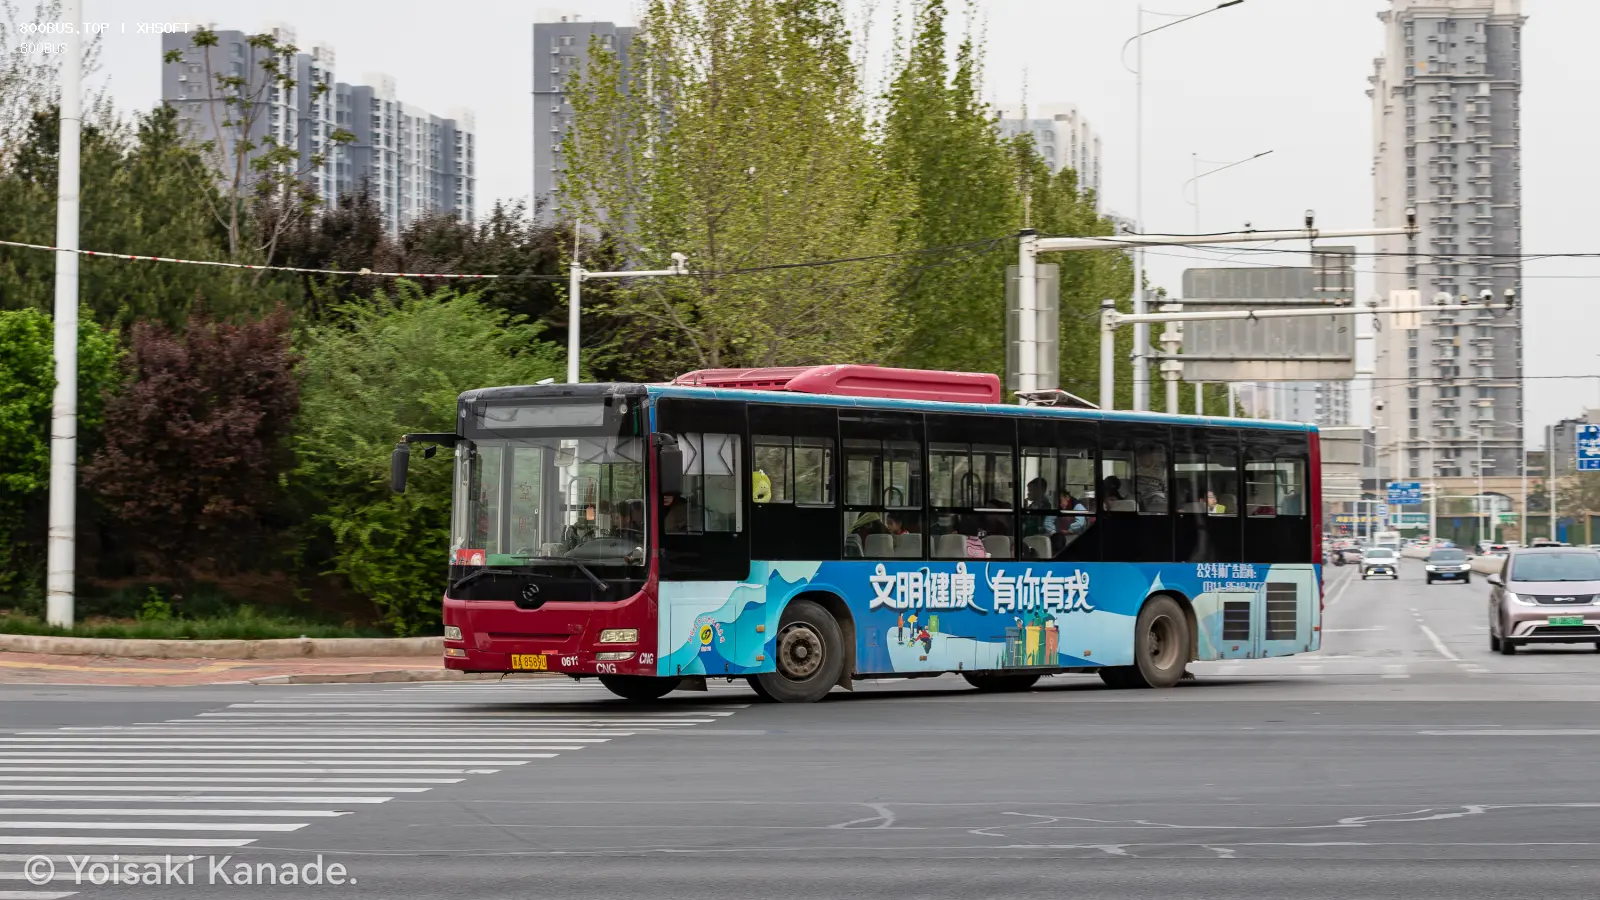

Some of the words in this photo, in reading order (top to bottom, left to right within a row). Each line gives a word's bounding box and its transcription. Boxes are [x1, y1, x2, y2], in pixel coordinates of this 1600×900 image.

[869, 562, 988, 613] 文明健康
[985, 562, 1095, 614] 有你有我
[639, 652, 654, 665] CNG
[596, 662, 617, 674] CNG
